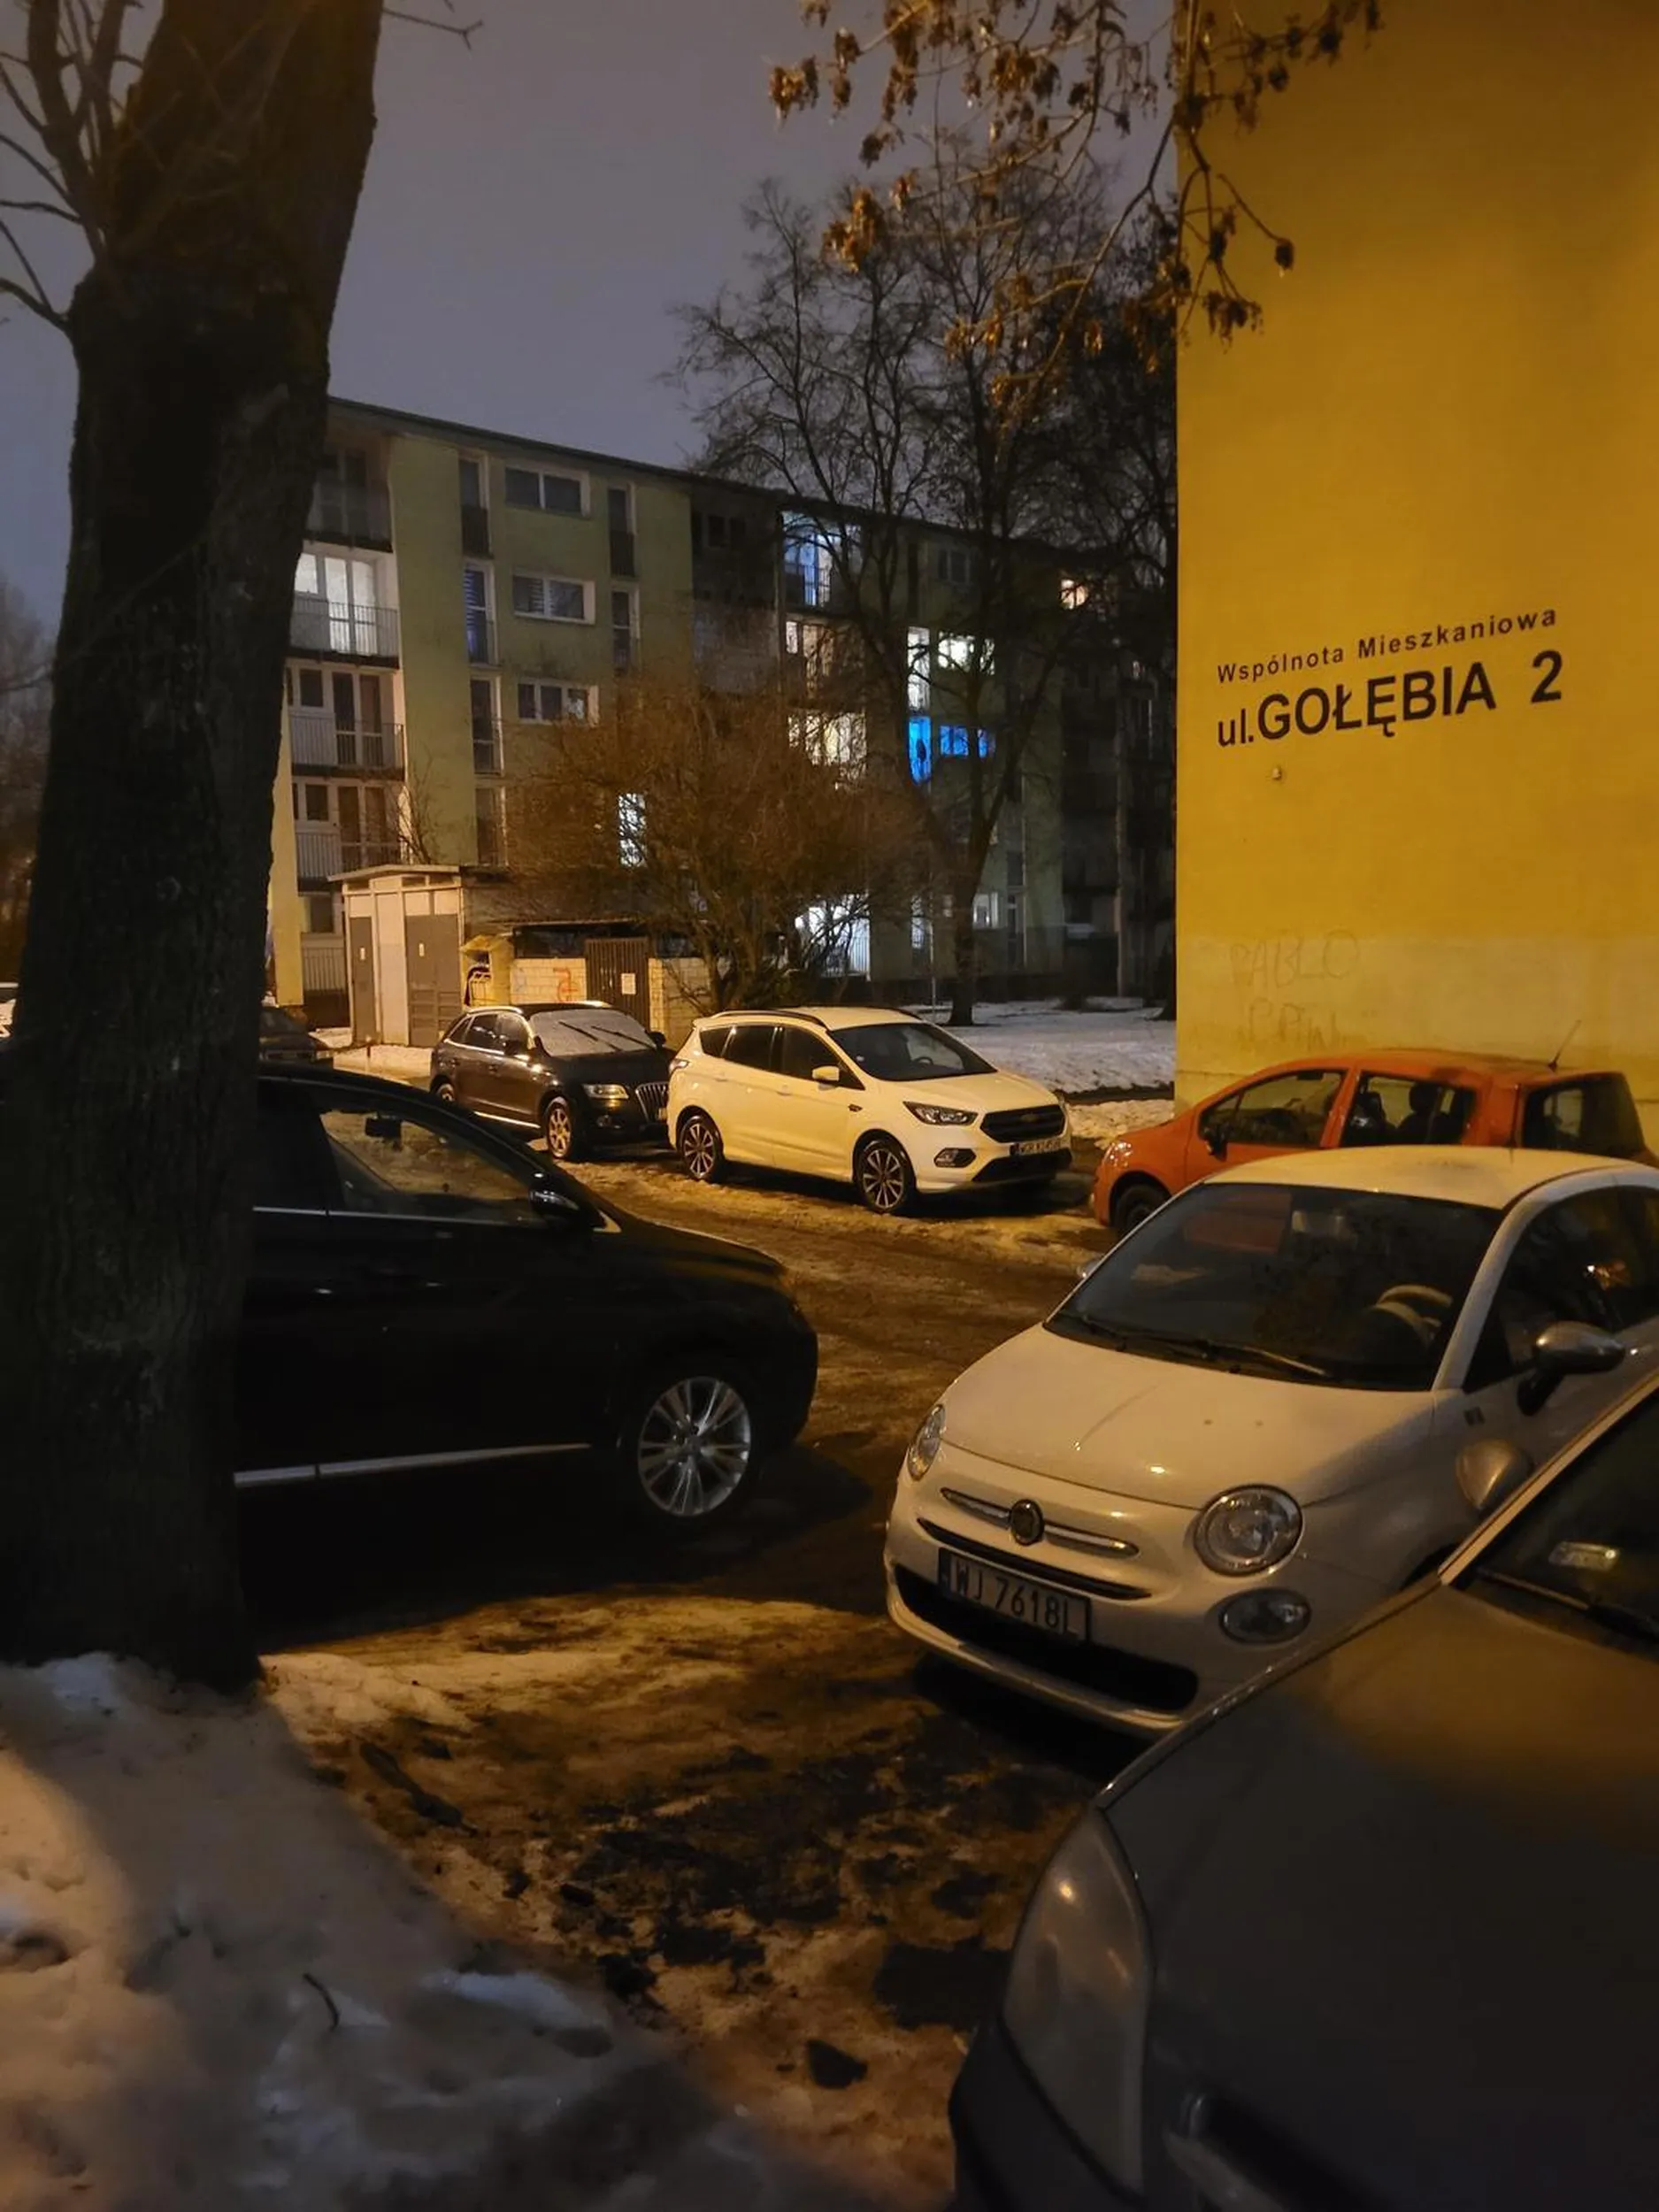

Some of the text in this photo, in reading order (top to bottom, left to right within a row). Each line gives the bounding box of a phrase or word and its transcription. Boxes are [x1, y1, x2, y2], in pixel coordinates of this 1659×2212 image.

[1217, 608, 1557, 684] Wspólnota Mieszkaniowa
[1530, 649, 1563, 704] 2
